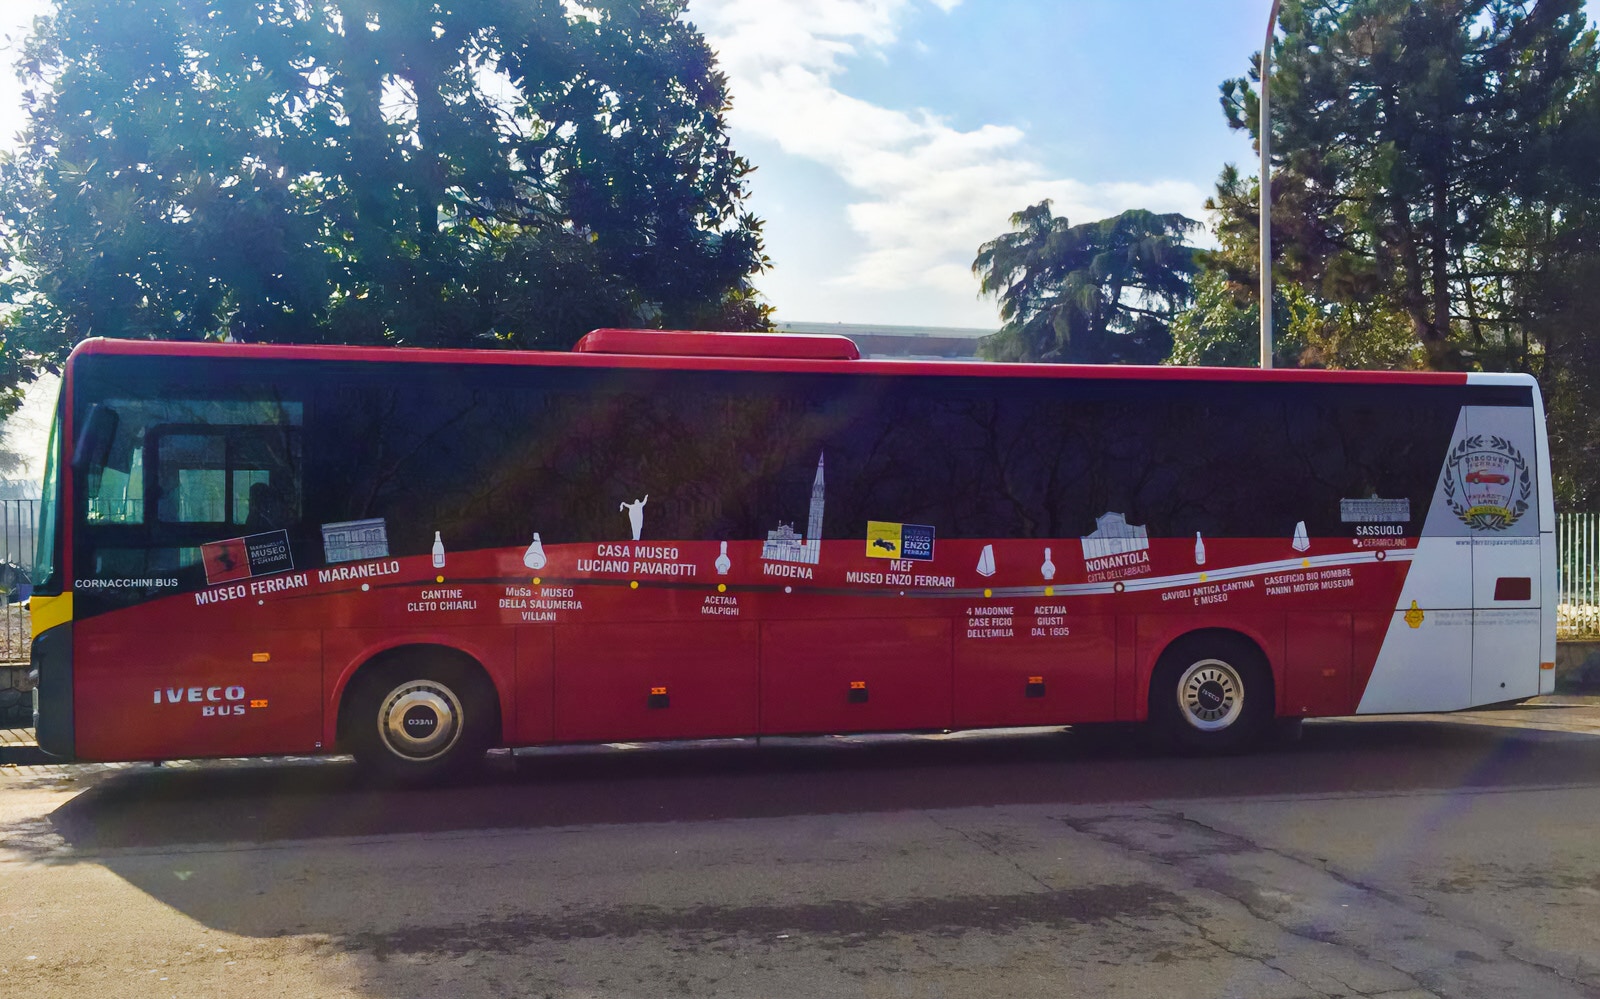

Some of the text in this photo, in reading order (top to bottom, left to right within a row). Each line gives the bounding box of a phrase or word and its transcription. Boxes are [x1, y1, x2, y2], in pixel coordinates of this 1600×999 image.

[1356, 525, 1403, 536] SASSUOLO
[250, 545, 286, 558] MUSEO
[904, 541, 930, 550] ENZO
[597, 544, 679, 560] CASA MUSEO
[577, 559, 697, 576] LUCIANO PAVAROTTI
[890, 560, 914, 572] MEF
[1085, 551, 1150, 573] NONANTOLA
[318, 560, 400, 583] MARANELLO
[763, 563, 813, 580] MODENA
[1264, 568, 1352, 585] CASEIFICIO BIO HOMBRE
[75, 578, 178, 588] CORNACCHINI BUS
[846, 572, 955, 588] MUSEO ENZO FERRARI
[194, 573, 308, 606] MUSEO FERRARI
[505, 587, 532, 597] MuSa
[540, 588, 574, 598] MUSEO
[1161, 579, 1255, 601] GAVIOLI ANTICA CANTINA
[1266, 578, 1354, 596] PANINI MOTOR MUSEUM
[421, 589, 463, 600] CANTINE
[704, 595, 737, 605] ACETAIA
[1194, 593, 1228, 606] E MUSEO
[407, 600, 477, 612] CLETO CHIARLI
[499, 599, 583, 610] DELLA SALUMERIA
[1034, 606, 1067, 615] ACETAIA
[521, 611, 557, 621] VILLANI
[701, 606, 739, 616] MALPIGHI
[966, 606, 1014, 616] 4 MADONNE
[1037, 617, 1064, 626] GIUSTI
[967, 628, 1014, 638] DELL'EMILIA
[1031, 627, 1070, 637] DAL 1605
[152, 686, 247, 705] IVECO
[1201, 688, 1220, 702] IVECO
[202, 704, 247, 717] BUS
